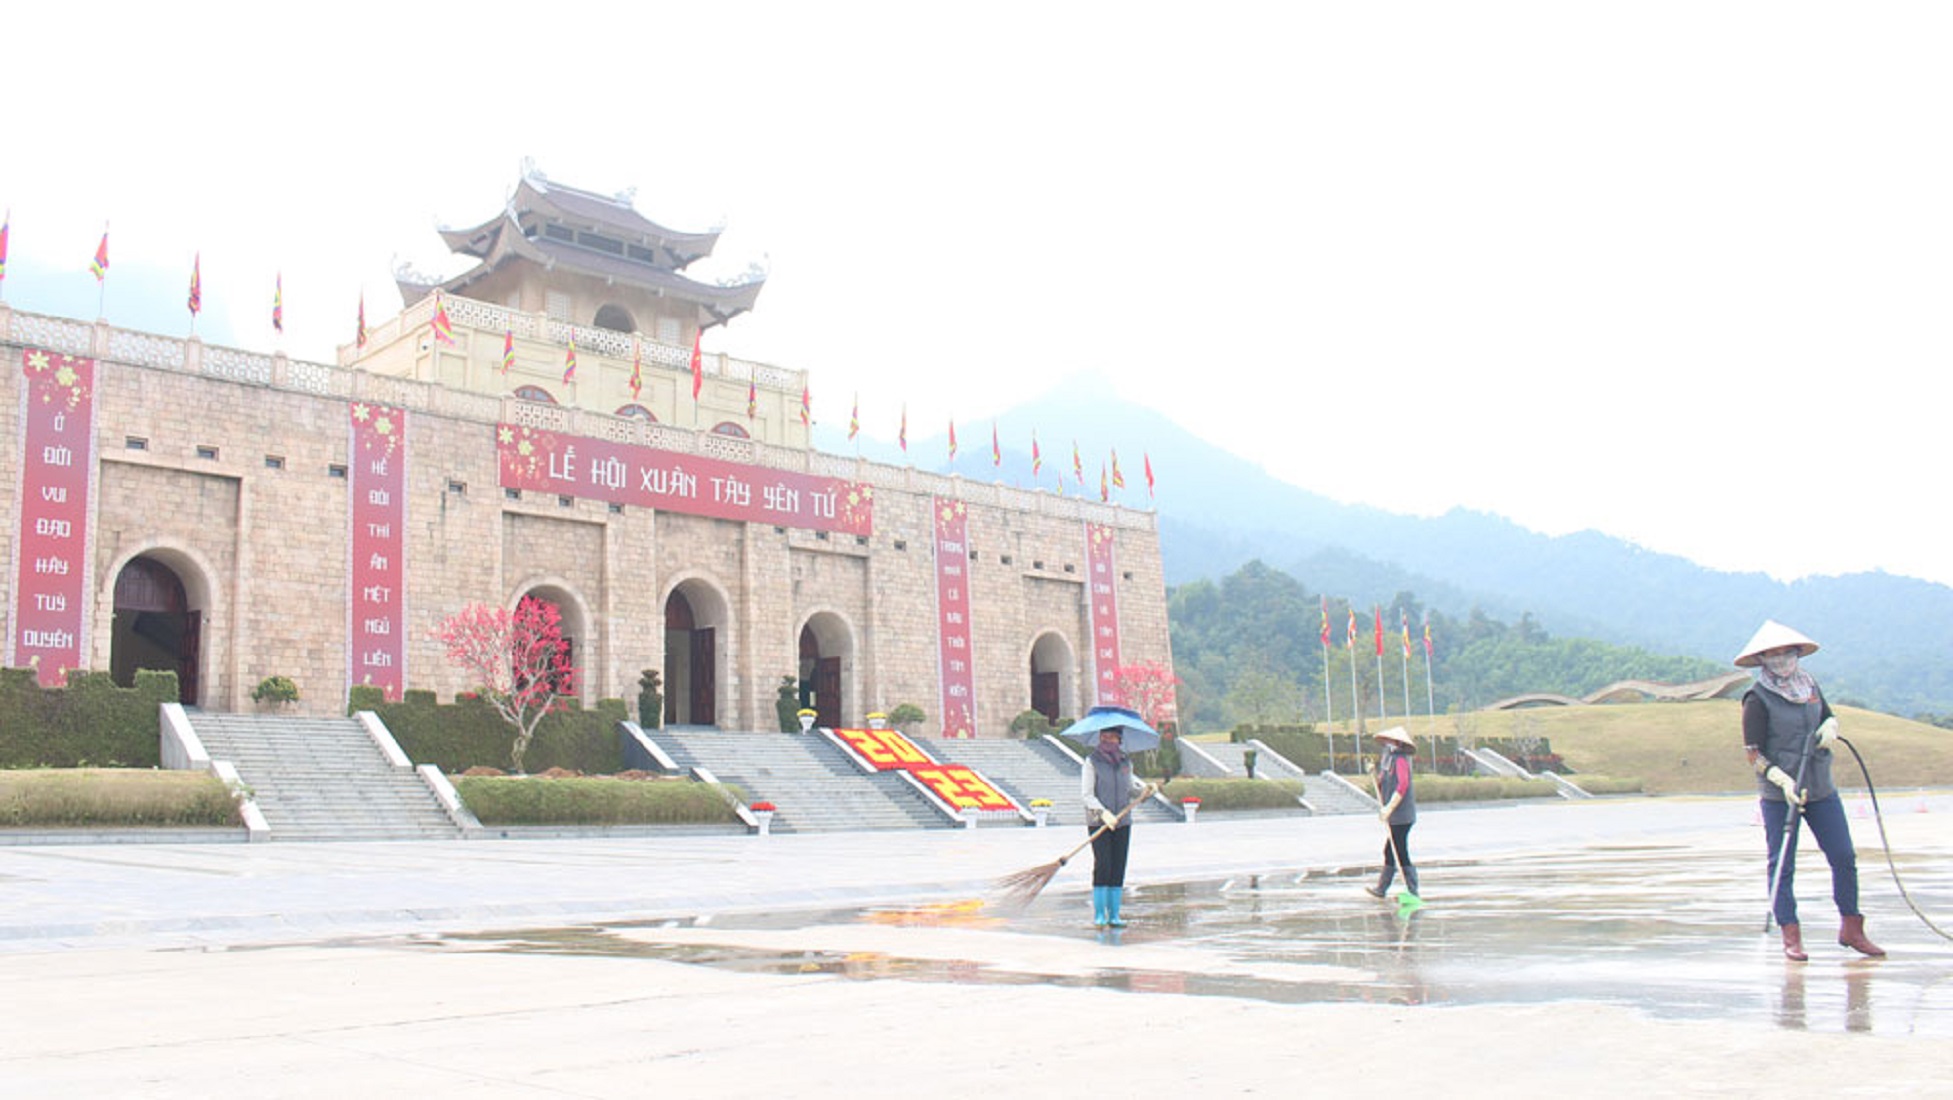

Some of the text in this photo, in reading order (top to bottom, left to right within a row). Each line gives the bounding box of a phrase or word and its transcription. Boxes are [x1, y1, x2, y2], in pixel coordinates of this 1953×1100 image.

[549, 445, 576, 482] LỄ
[591, 456, 627, 491] HỘI
[640, 465, 697, 499] XUÂN
[710, 474, 751, 506] TÂY
[763, 482, 800, 513] YÊN
[42, 486, 67, 503] VUI
[36, 517, 71, 540] ĐẠO
[23, 628, 73, 649] DUYÊN
